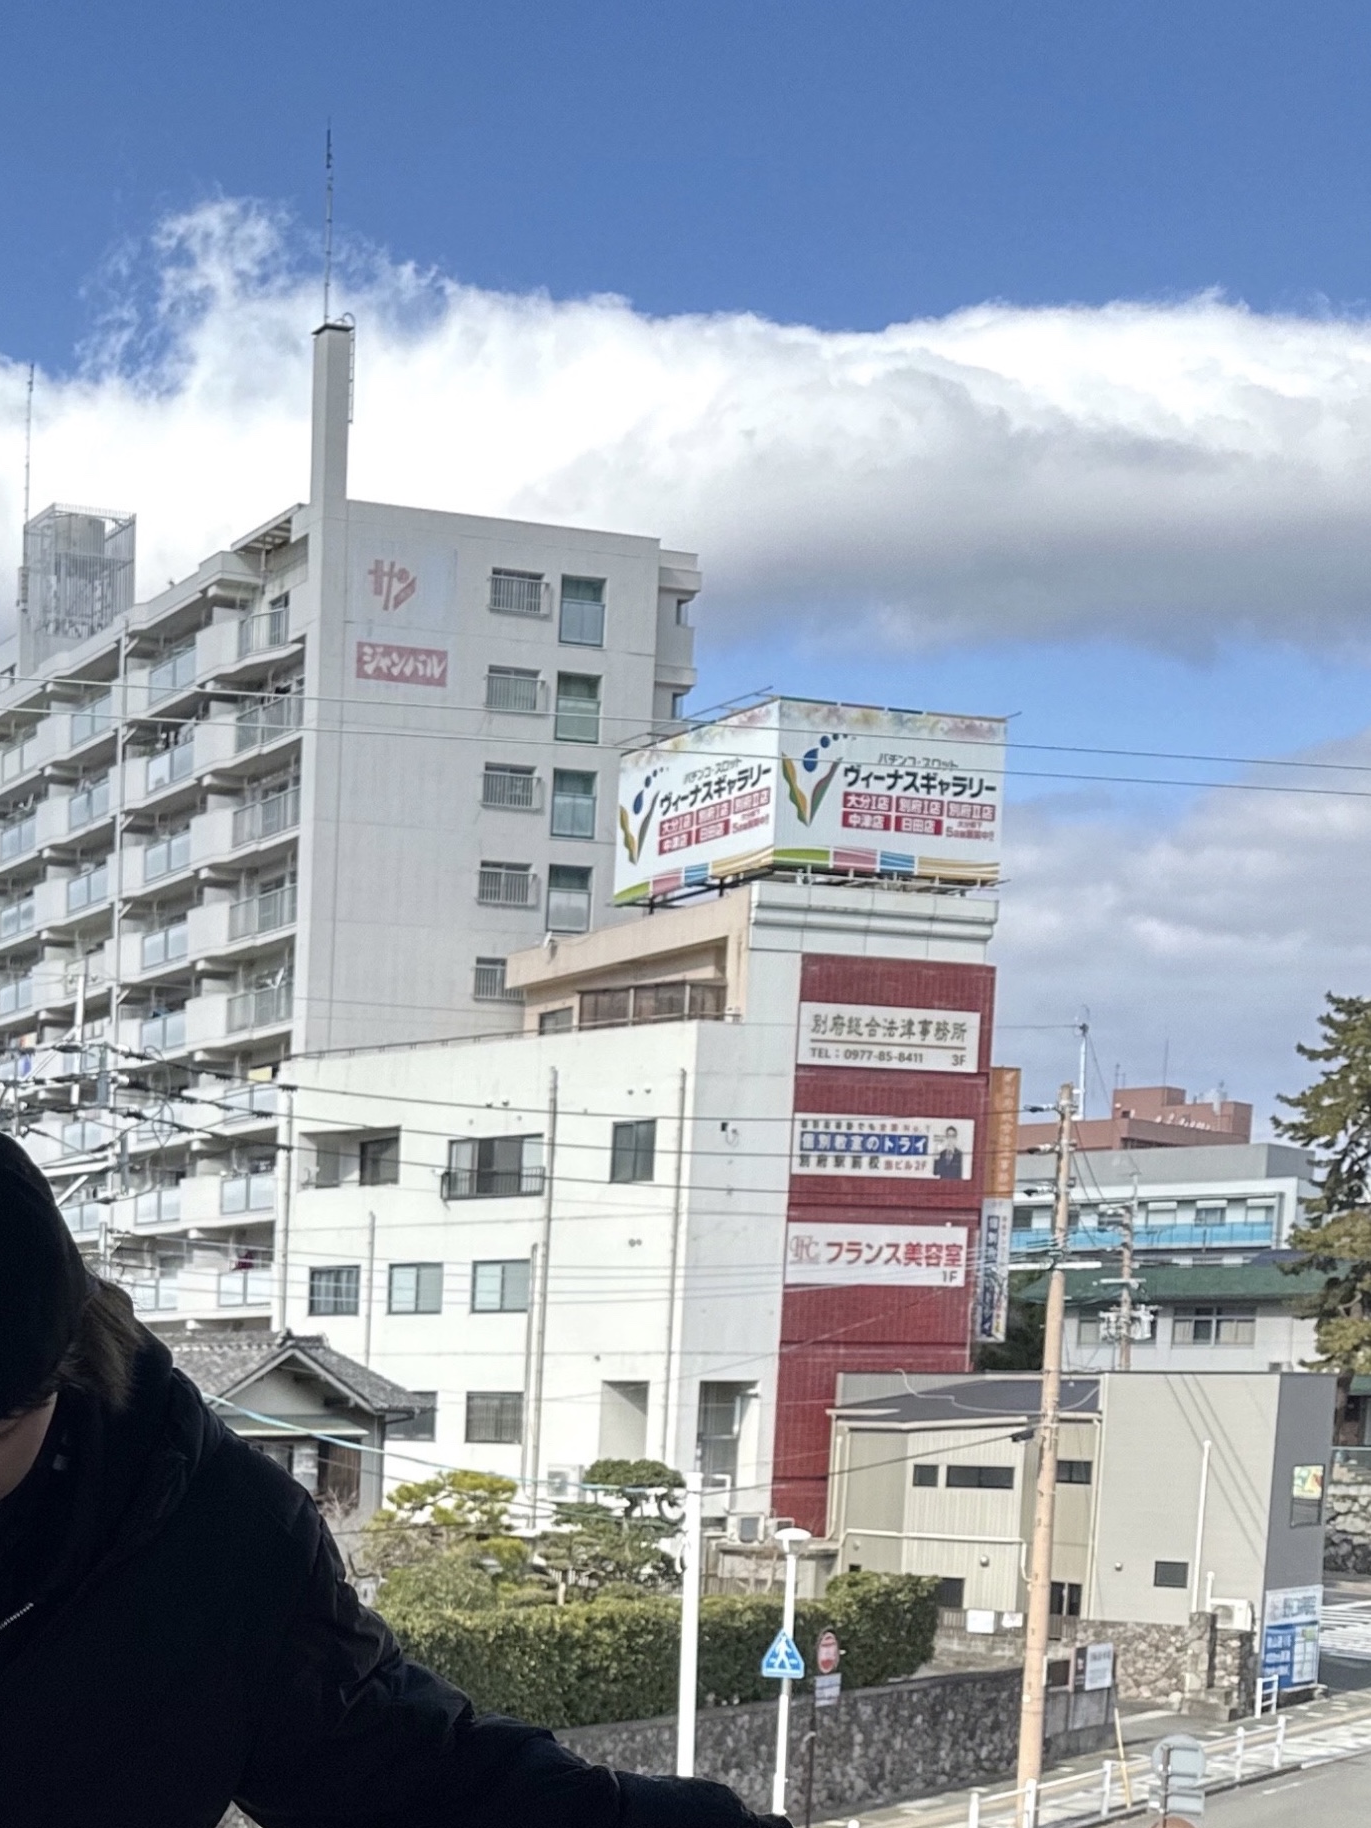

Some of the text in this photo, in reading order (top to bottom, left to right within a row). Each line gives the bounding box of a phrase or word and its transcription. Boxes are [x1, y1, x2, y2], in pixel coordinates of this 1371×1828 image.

[659, 763, 772, 816] ヴィーナスギャラリー
[843, 764, 997, 798] ヴィーナスギャラリー
[810, 1013, 968, 1043] 別府総合法律事務所
[951, 1053, 967, 1067] 3F
[826, 1241, 963, 1267] フランス美容室
[941, 1270, 958, 1283] 1F
